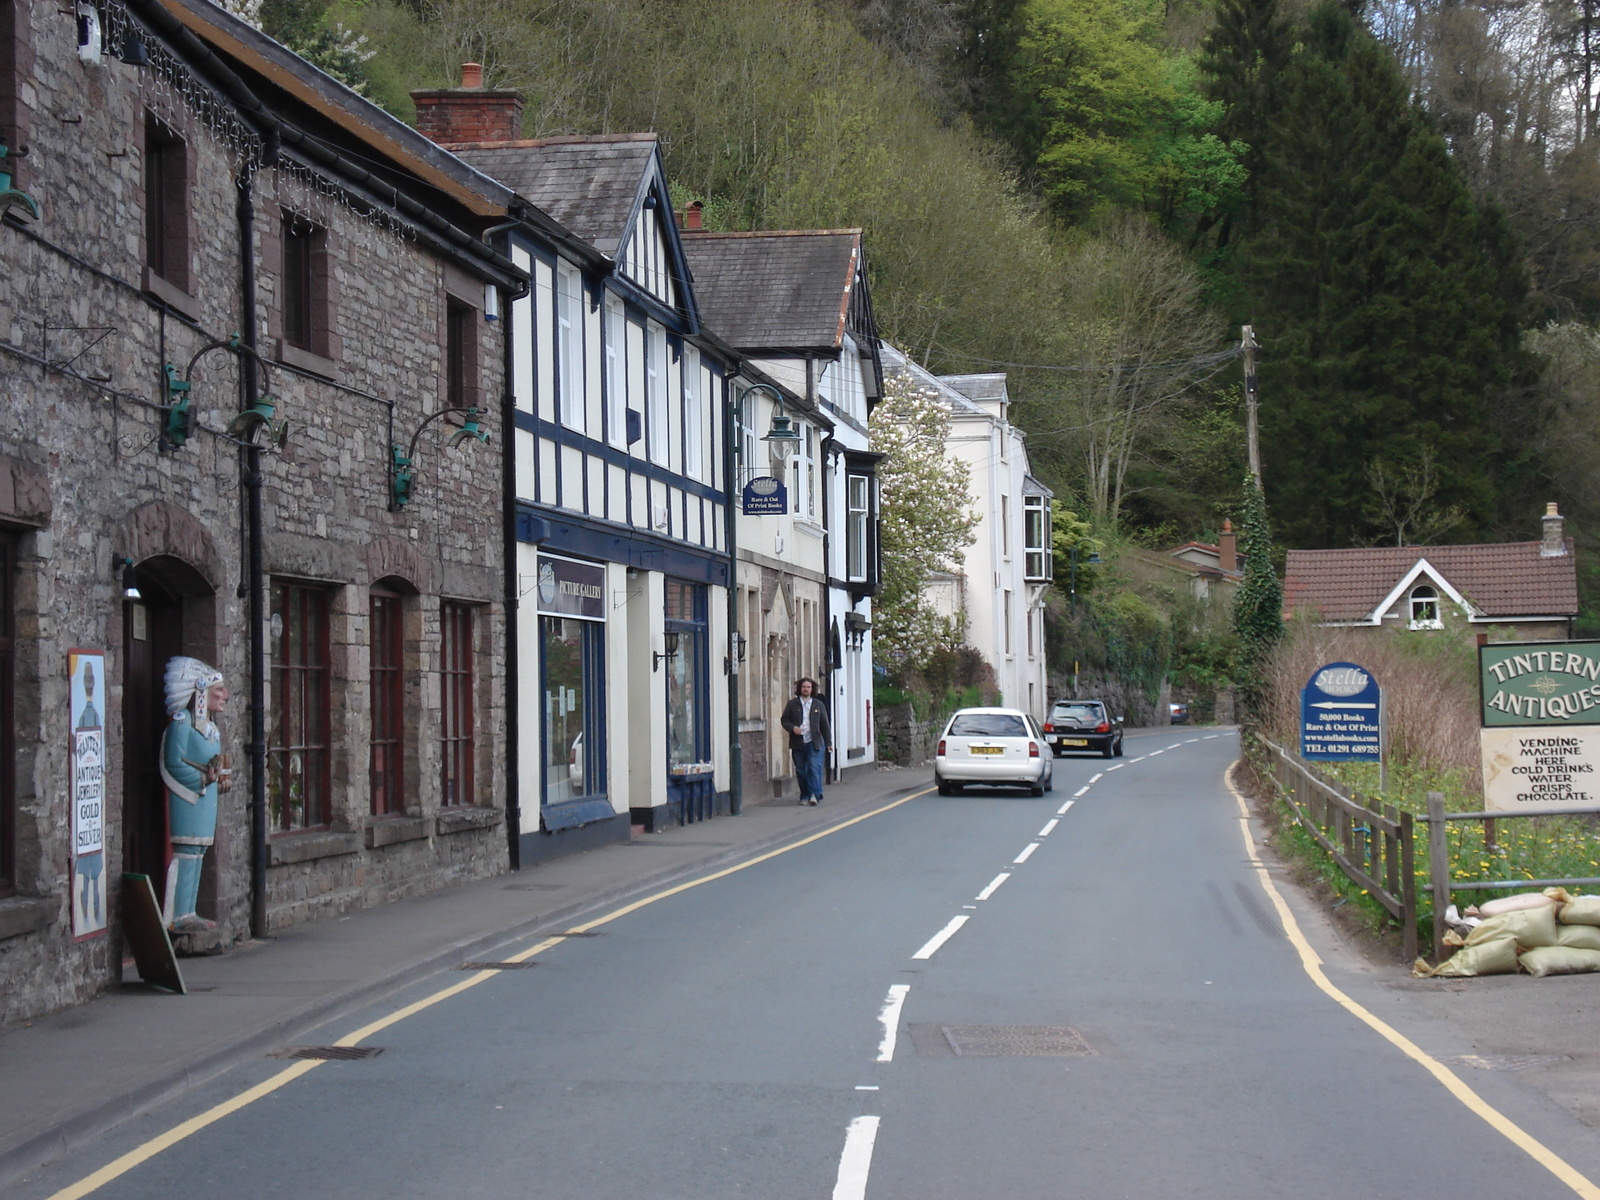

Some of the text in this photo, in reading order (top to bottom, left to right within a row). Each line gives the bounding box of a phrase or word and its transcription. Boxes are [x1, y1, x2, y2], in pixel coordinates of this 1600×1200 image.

[751, 478, 778, 488] Stella
[559, 580, 580, 596] PICTURE
[580, 584, 602, 599] GALLERY
[1488, 651, 1600, 684] TINTERN
[1315, 667, 1369, 686] Stella
[1325, 685, 1360, 693] BOOKS
[1487, 684, 1600, 720] ANTIQUES
[1319, 713, 1365, 722] 50,000 Books
[1306, 723, 1379, 732] Rare & Out Of Print
[1305, 734, 1378, 742] www.stellabooks.com
[1305, 744, 1327, 753] TEL:
[1328, 744, 1350, 753] 01291
[1520, 747, 1582, 756] MACHINE
[1535, 757, 1567, 765] HERE
[77, 766, 101, 782] ANTIQUE
[1511, 766, 1543, 774] COLD
[77, 784, 101, 801] JEWELLERY
[1531, 784, 1573, 792] CRISPS
[80, 803, 99, 819] GOLD
[78, 829, 101, 847] SILVER
